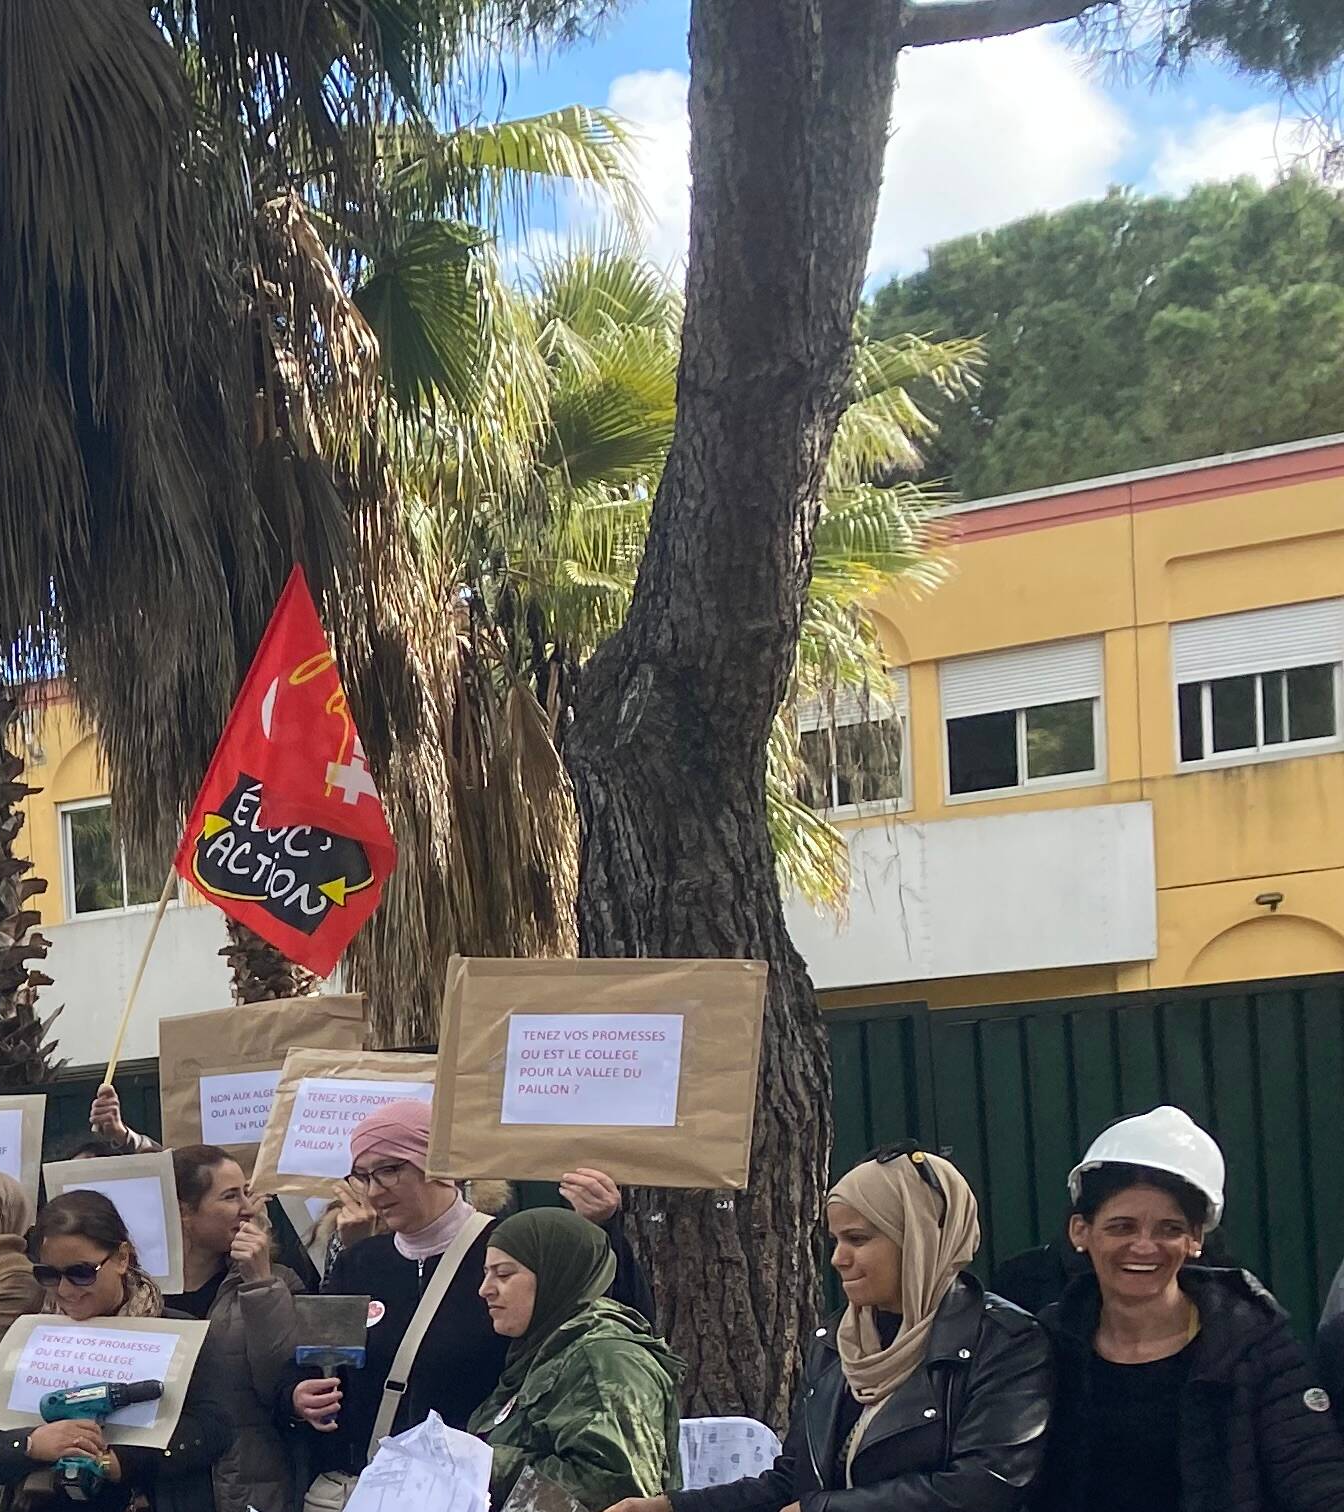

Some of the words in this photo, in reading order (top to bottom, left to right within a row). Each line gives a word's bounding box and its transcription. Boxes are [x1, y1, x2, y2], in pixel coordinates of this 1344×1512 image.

[522, 1030, 561, 1041] TENEZ
[564, 1030, 589, 1041] VOS
[592, 1030, 666, 1042] PROMESSES
[544, 1049, 563, 1060] EST
[568, 1049, 582, 1060] LE
[584, 1050, 639, 1061] COLLEGE
[519, 1067, 554, 1078] POUR
[558, 1067, 572, 1077] LA
[576, 1067, 620, 1078] VALLEE
[623, 1067, 642, 1078] DU
[232, 1092, 251, 1101] AUX
[253, 1088, 276, 1098] ALGE
[518, 1084, 569, 1095] PAILLON
[308, 1092, 338, 1103] TENEZ
[338, 1094, 359, 1104] VOS
[253, 1104, 272, 1114] COL
[319, 1110, 338, 1120] EST
[339, 1111, 350, 1120] LE
[298, 1124, 327, 1135] POUR
[328, 1126, 340, 1136] LA
[294, 1139, 335, 1151] PAILLON
[41, 1334, 73, 1345] TENEZ
[76, 1338, 97, 1347] VOS
[98, 1339, 161, 1354] PROMESSES
[54, 1350, 73, 1360] EST
[74, 1352, 86, 1361] LE
[87, 1352, 135, 1367] COLLEGE
[29, 1360, 60, 1372] POUR
[62, 1363, 75, 1373] LA
[77, 1365, 115, 1380] VALLEE
[117, 1370, 134, 1382] DU
[25, 1375, 70, 1389] PAILLON
